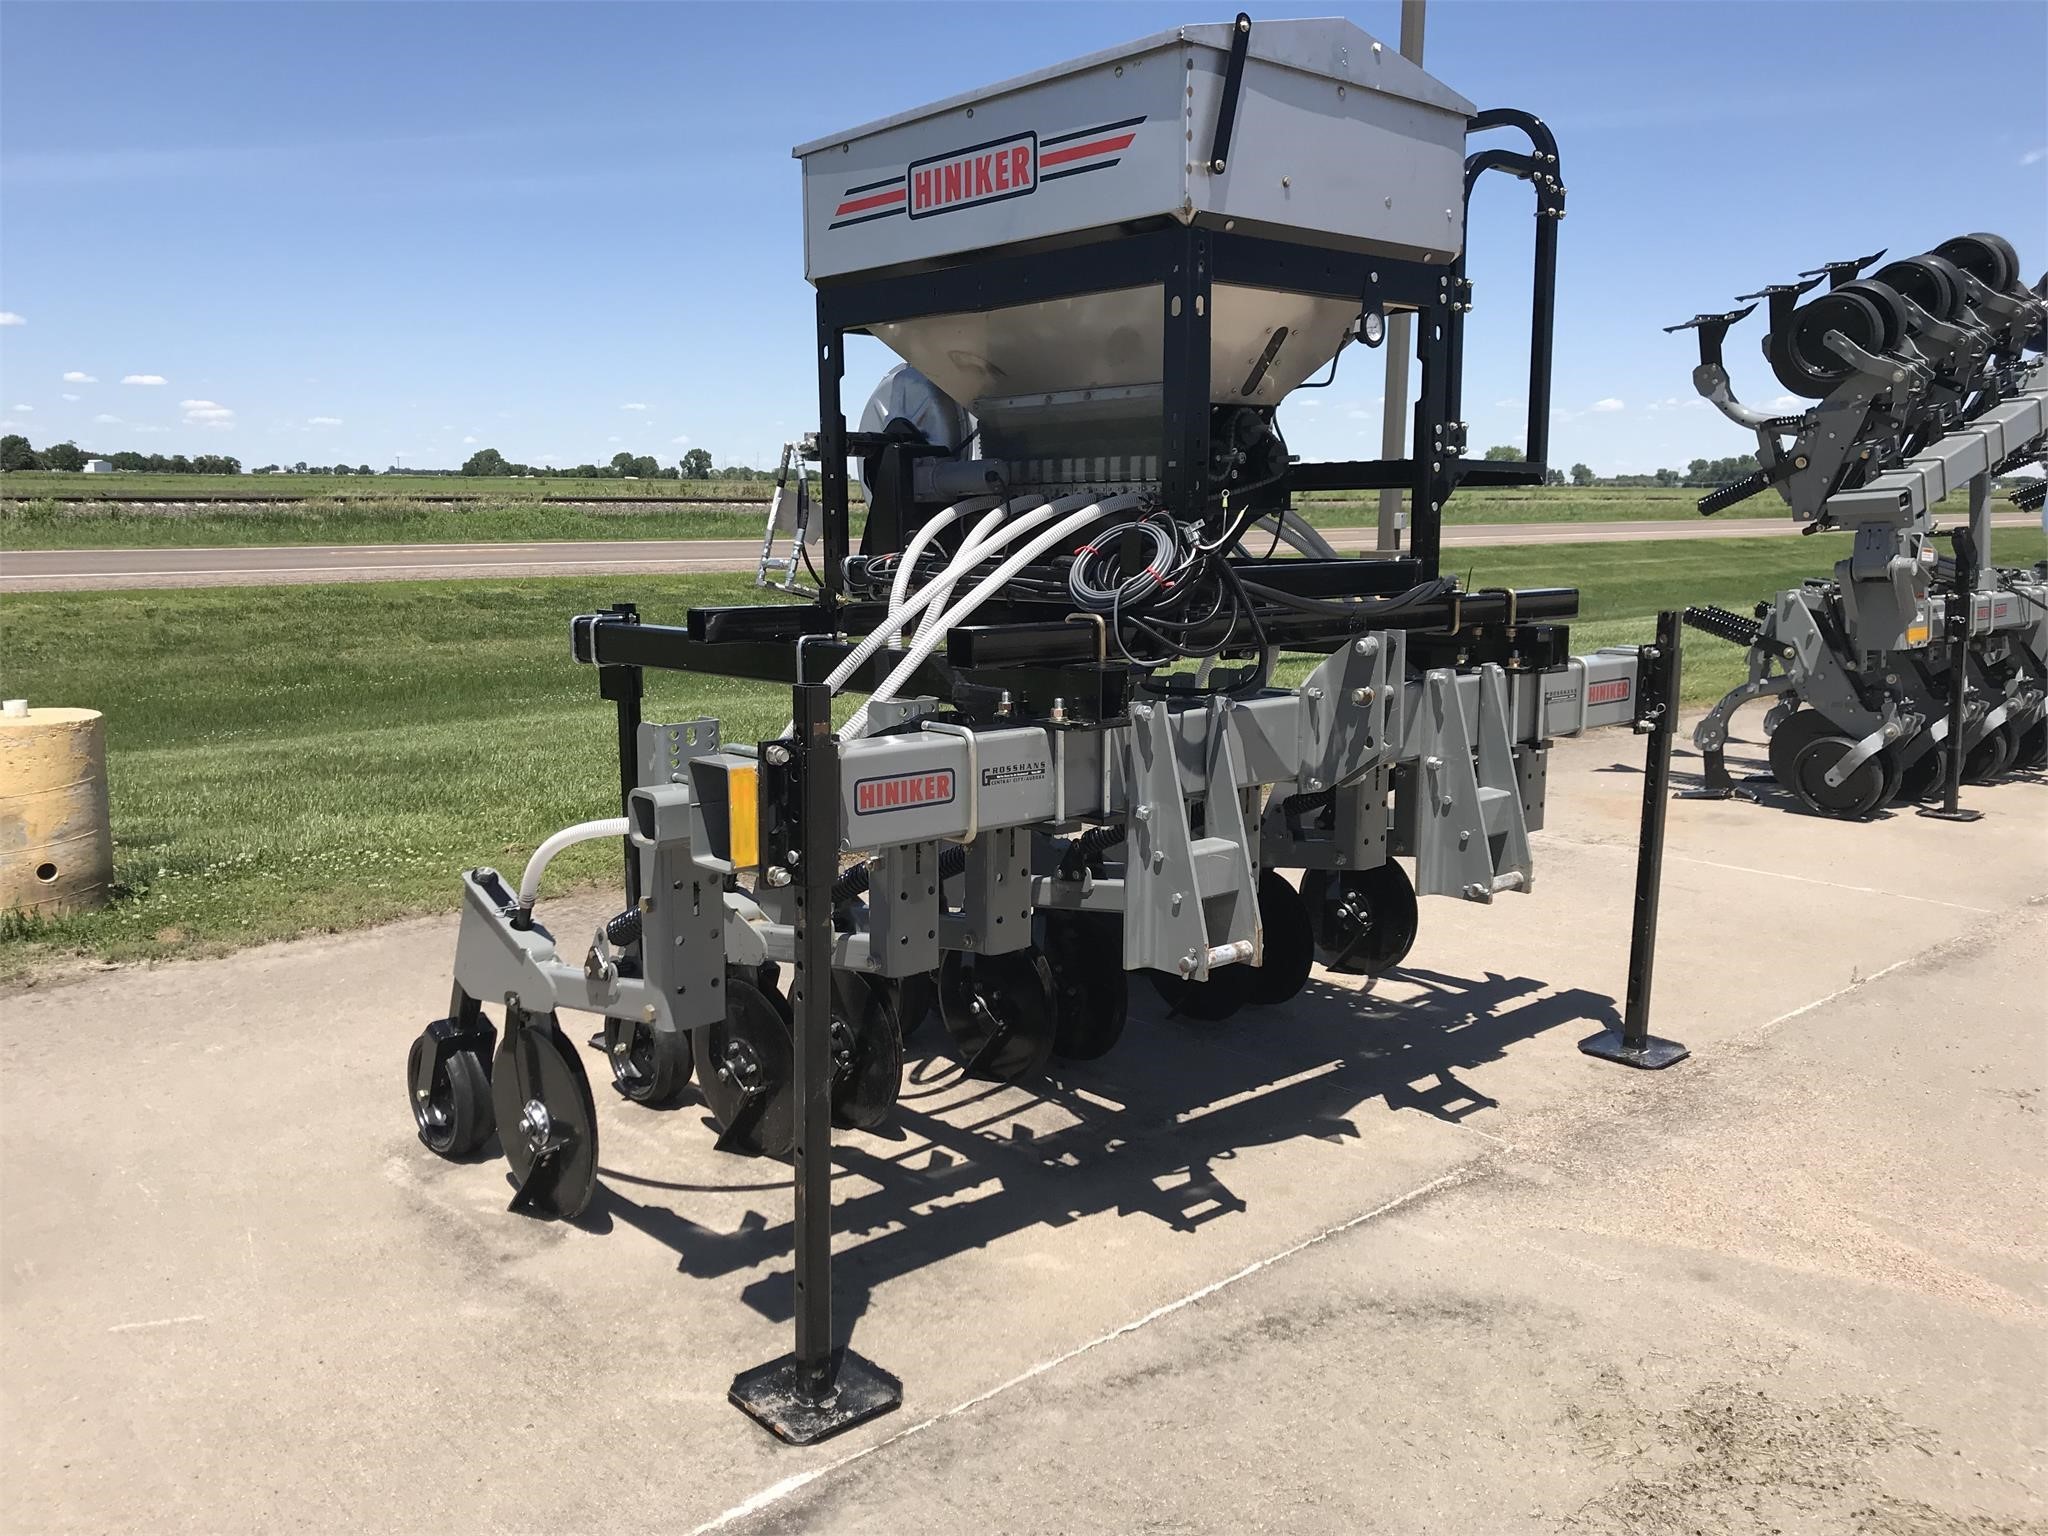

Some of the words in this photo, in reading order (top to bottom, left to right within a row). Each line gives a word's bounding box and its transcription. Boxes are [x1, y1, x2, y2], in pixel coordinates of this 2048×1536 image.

[915, 146, 1030, 209] HINIKER
[1589, 683, 1627, 702] HINIKER
[982, 761, 1046, 786] GROSSHANS
[860, 775, 950, 810] HINIKER
